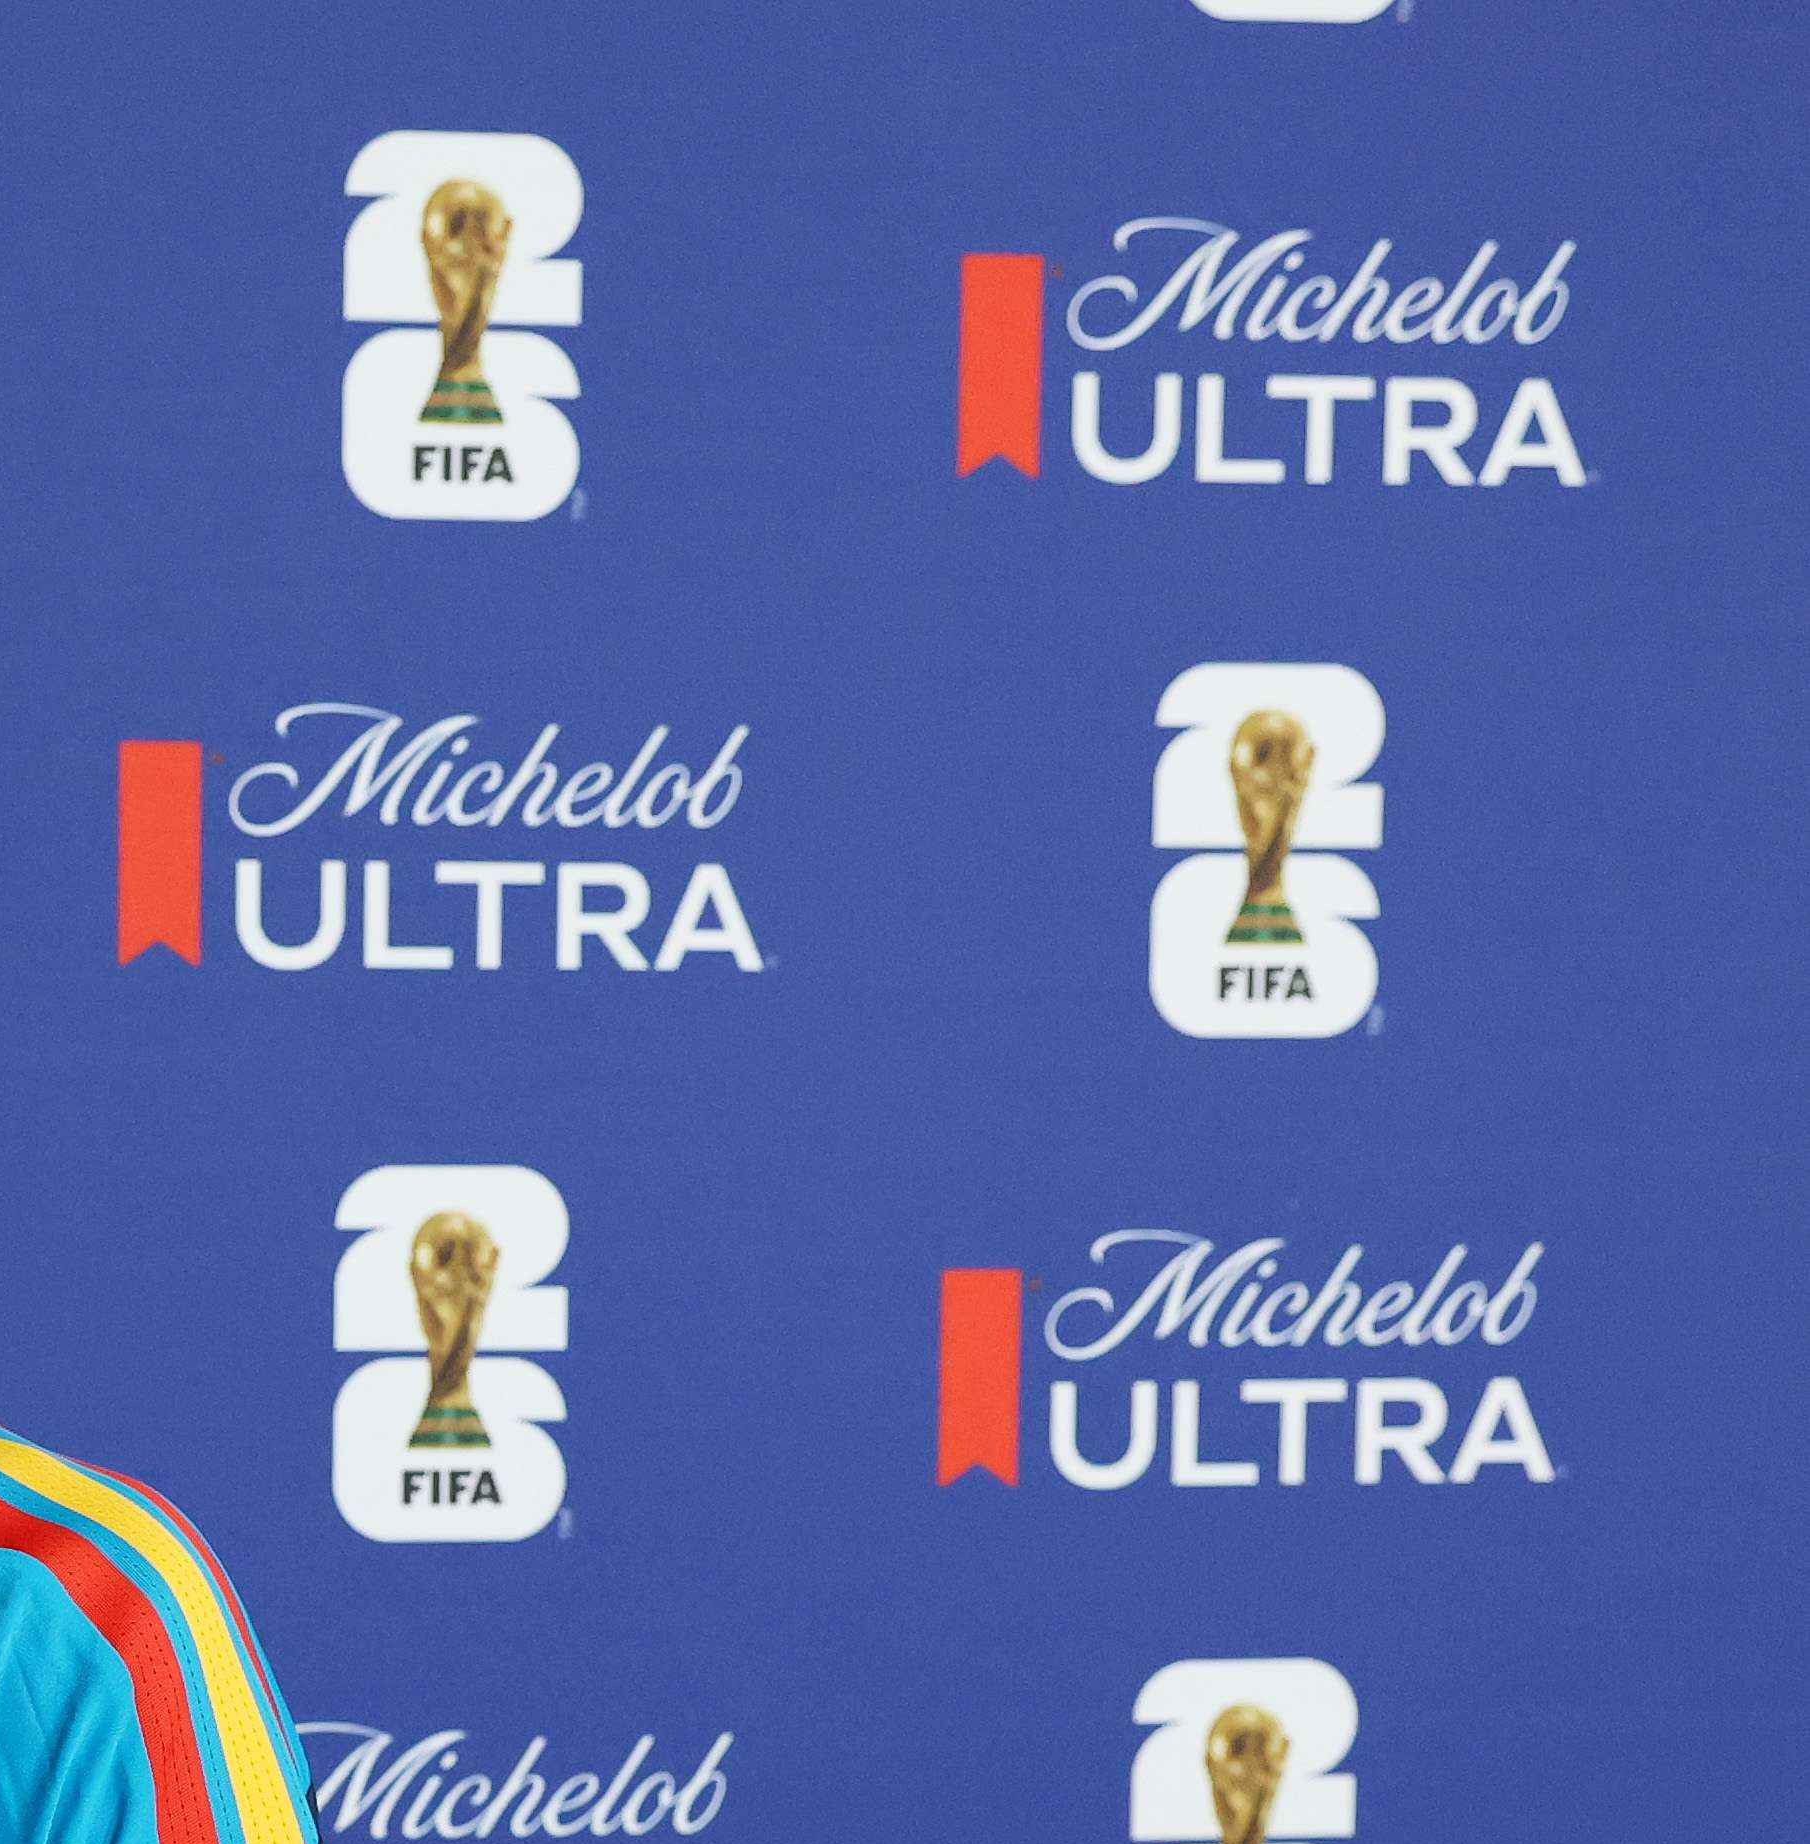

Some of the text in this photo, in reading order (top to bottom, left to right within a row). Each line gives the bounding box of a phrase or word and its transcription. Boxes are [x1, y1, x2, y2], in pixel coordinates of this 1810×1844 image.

[1067, 218, 1576, 351] Michelob
[414, 446, 513, 482] FIFA
[1072, 372, 1586, 486] ULTRA
[229, 703, 749, 837] Michelob
[236, 859, 763, 971] ULTRA
[1219, 967, 1311, 999] FIFA
[1045, 1230, 1544, 1361] Michelob
[402, 1470, 500, 1504] FIFA
[1050, 1377, 1554, 1489] ULTRA
